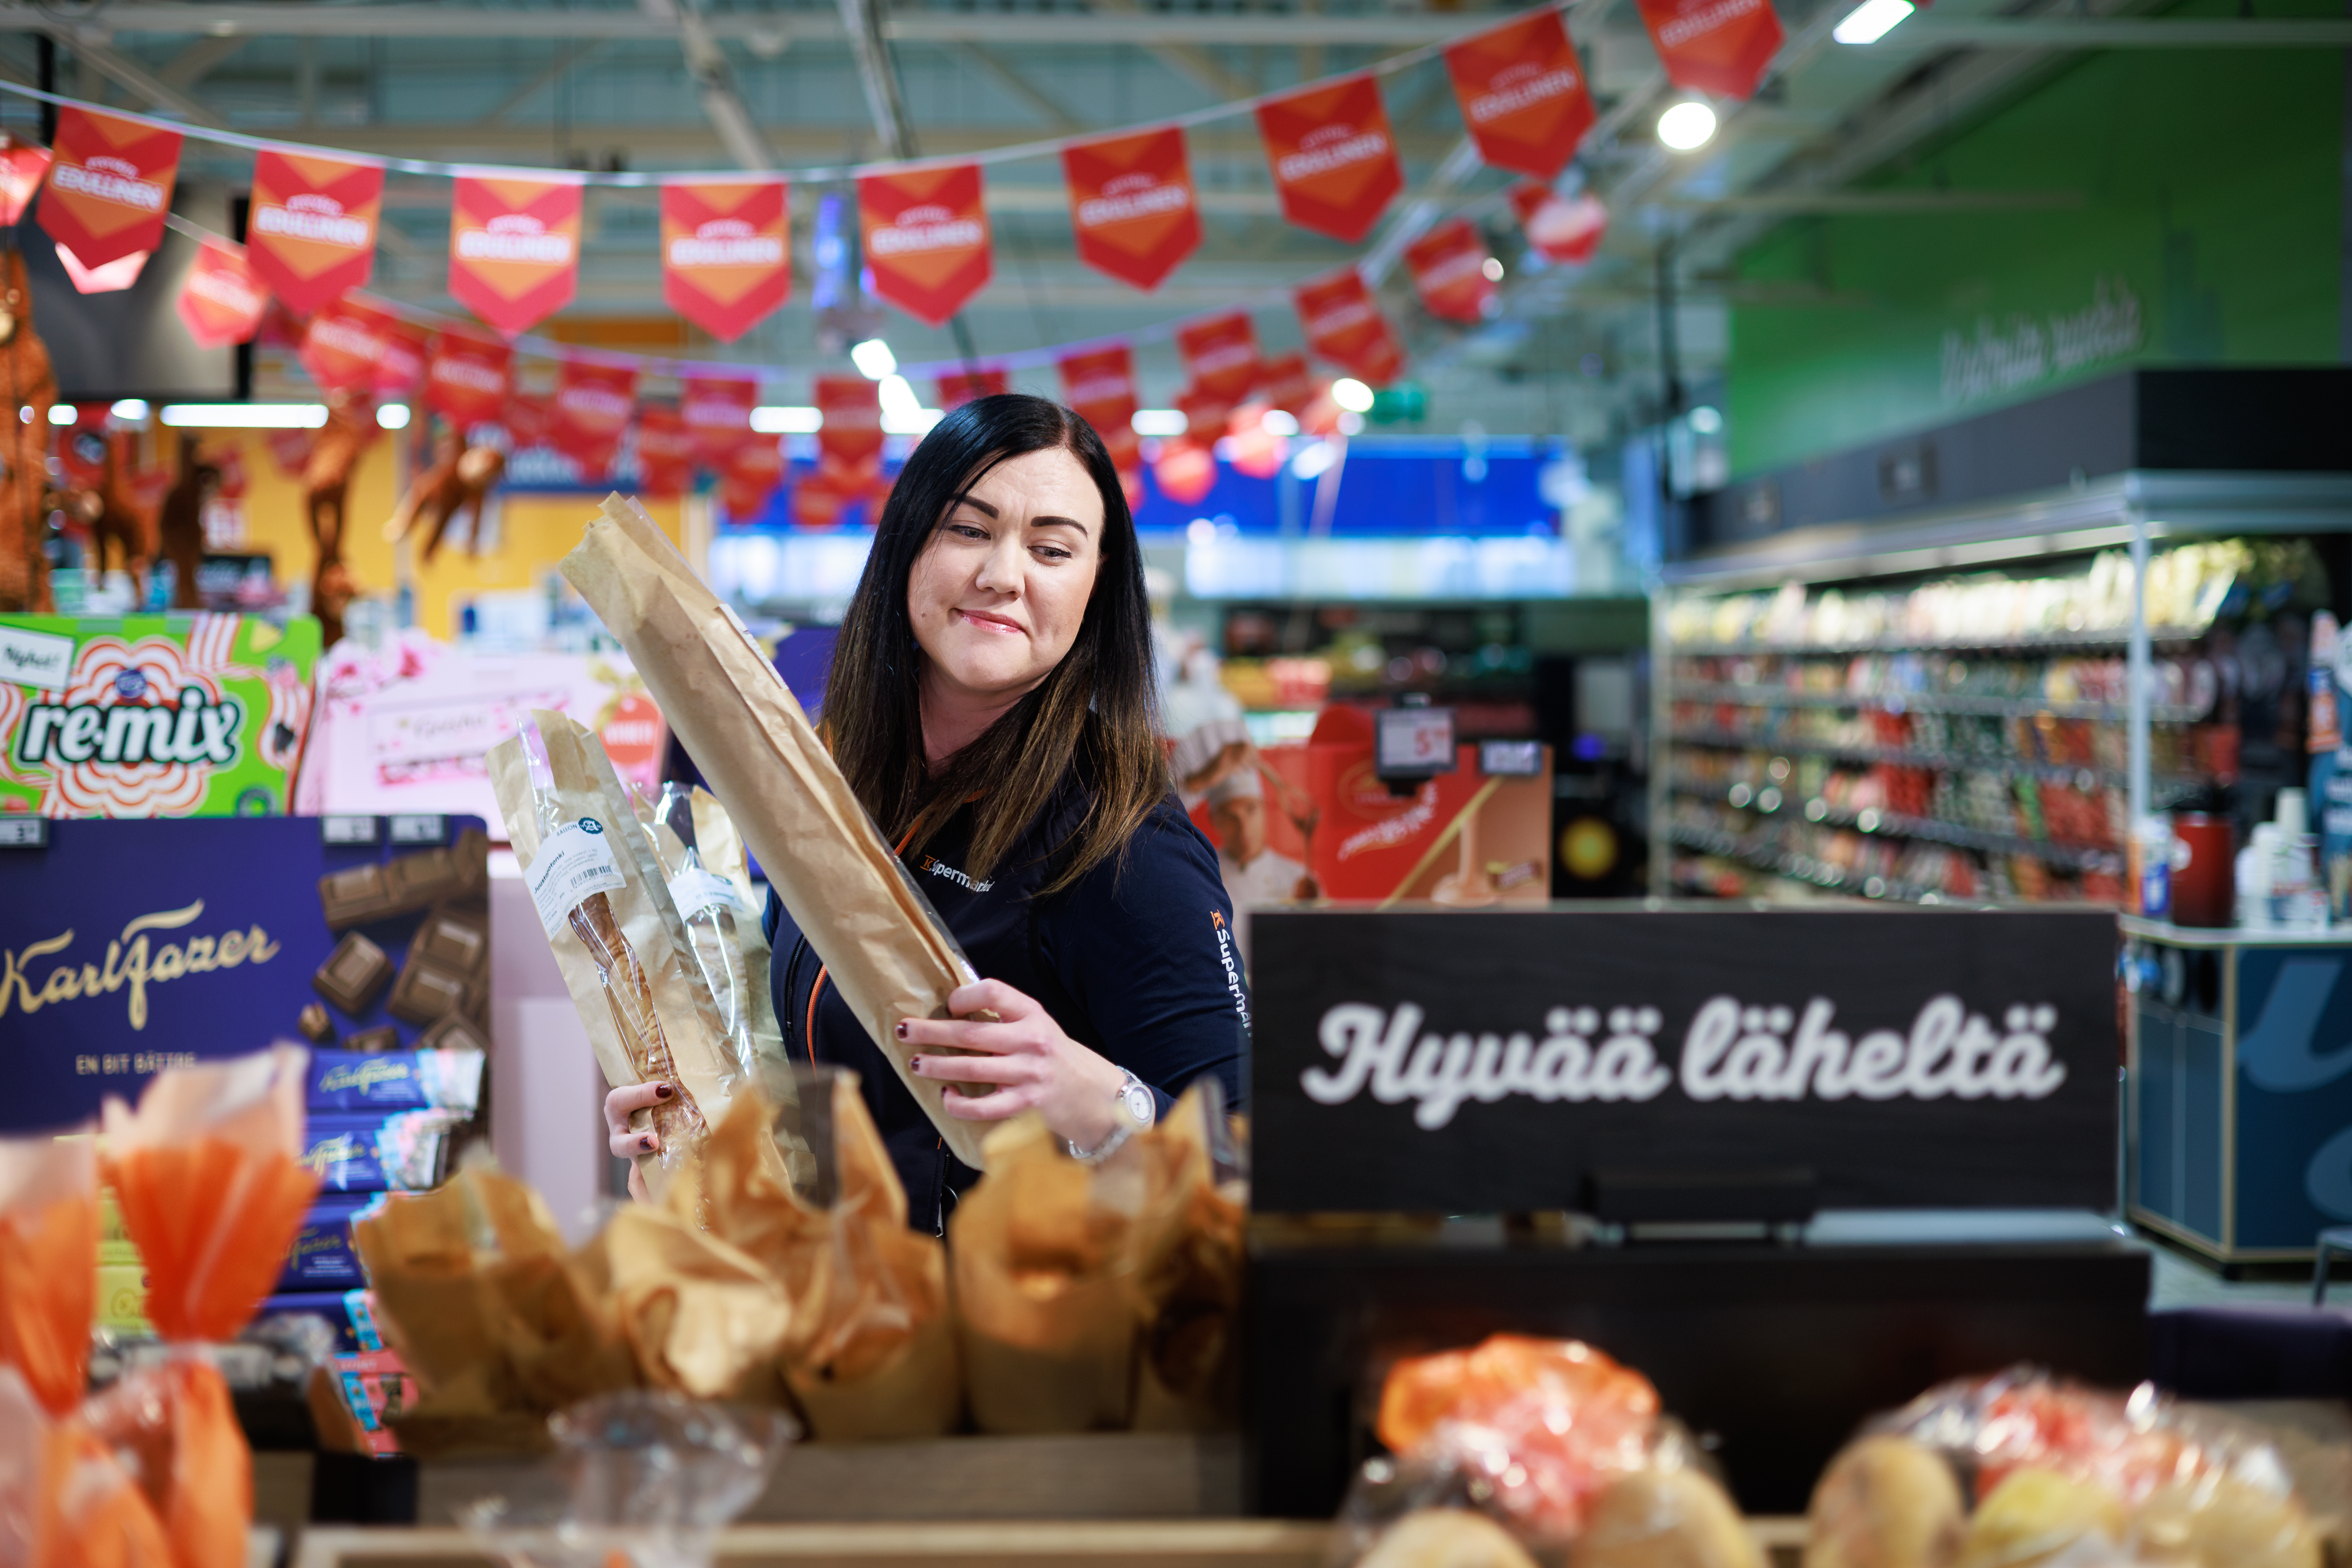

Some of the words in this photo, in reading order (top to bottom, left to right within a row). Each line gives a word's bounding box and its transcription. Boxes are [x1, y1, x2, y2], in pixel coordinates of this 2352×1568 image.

[54, 165, 163, 208] EDULLINEN
[257, 206, 368, 246] EDULLINEN
[556, 824, 578, 837] AALLON
[534, 850, 565, 894] Juustopatonki
[1210, 909, 1225, 930] K
[1217, 928, 1252, 1039] Supermar
[75, 1054, 100, 1075] EN
[102, 1054, 131, 1075] BIT
[1300, 1001, 1672, 1131] Hyvää
[1679, 994, 2067, 1101] läheltä
